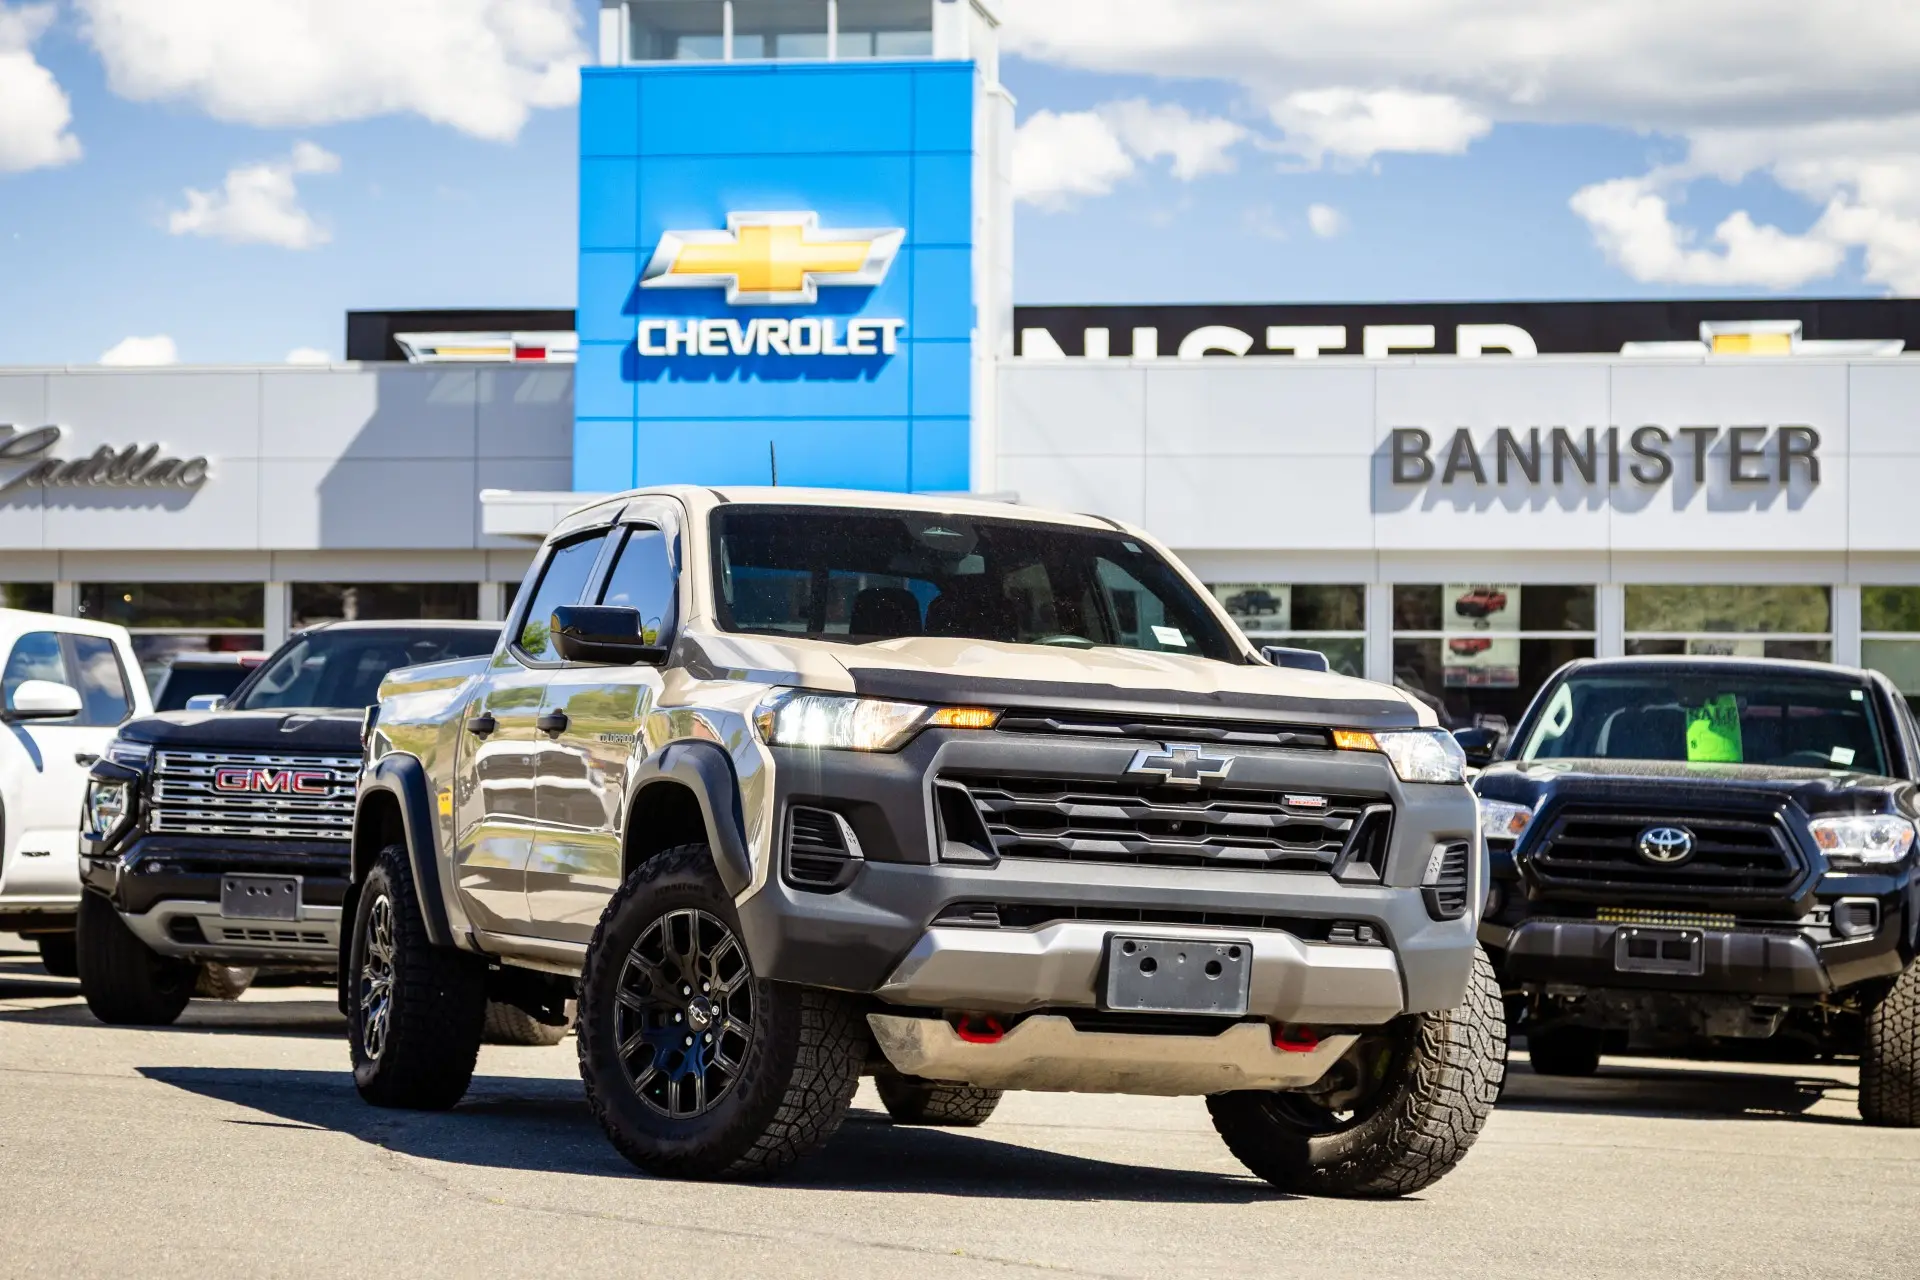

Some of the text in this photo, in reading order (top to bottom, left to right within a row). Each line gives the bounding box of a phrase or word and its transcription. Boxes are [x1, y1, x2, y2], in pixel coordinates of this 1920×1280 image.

[638, 318, 904, 356] CHEVROLET
[1391, 425, 1821, 485] BANNISTER
[215, 768, 331, 796] GMC
